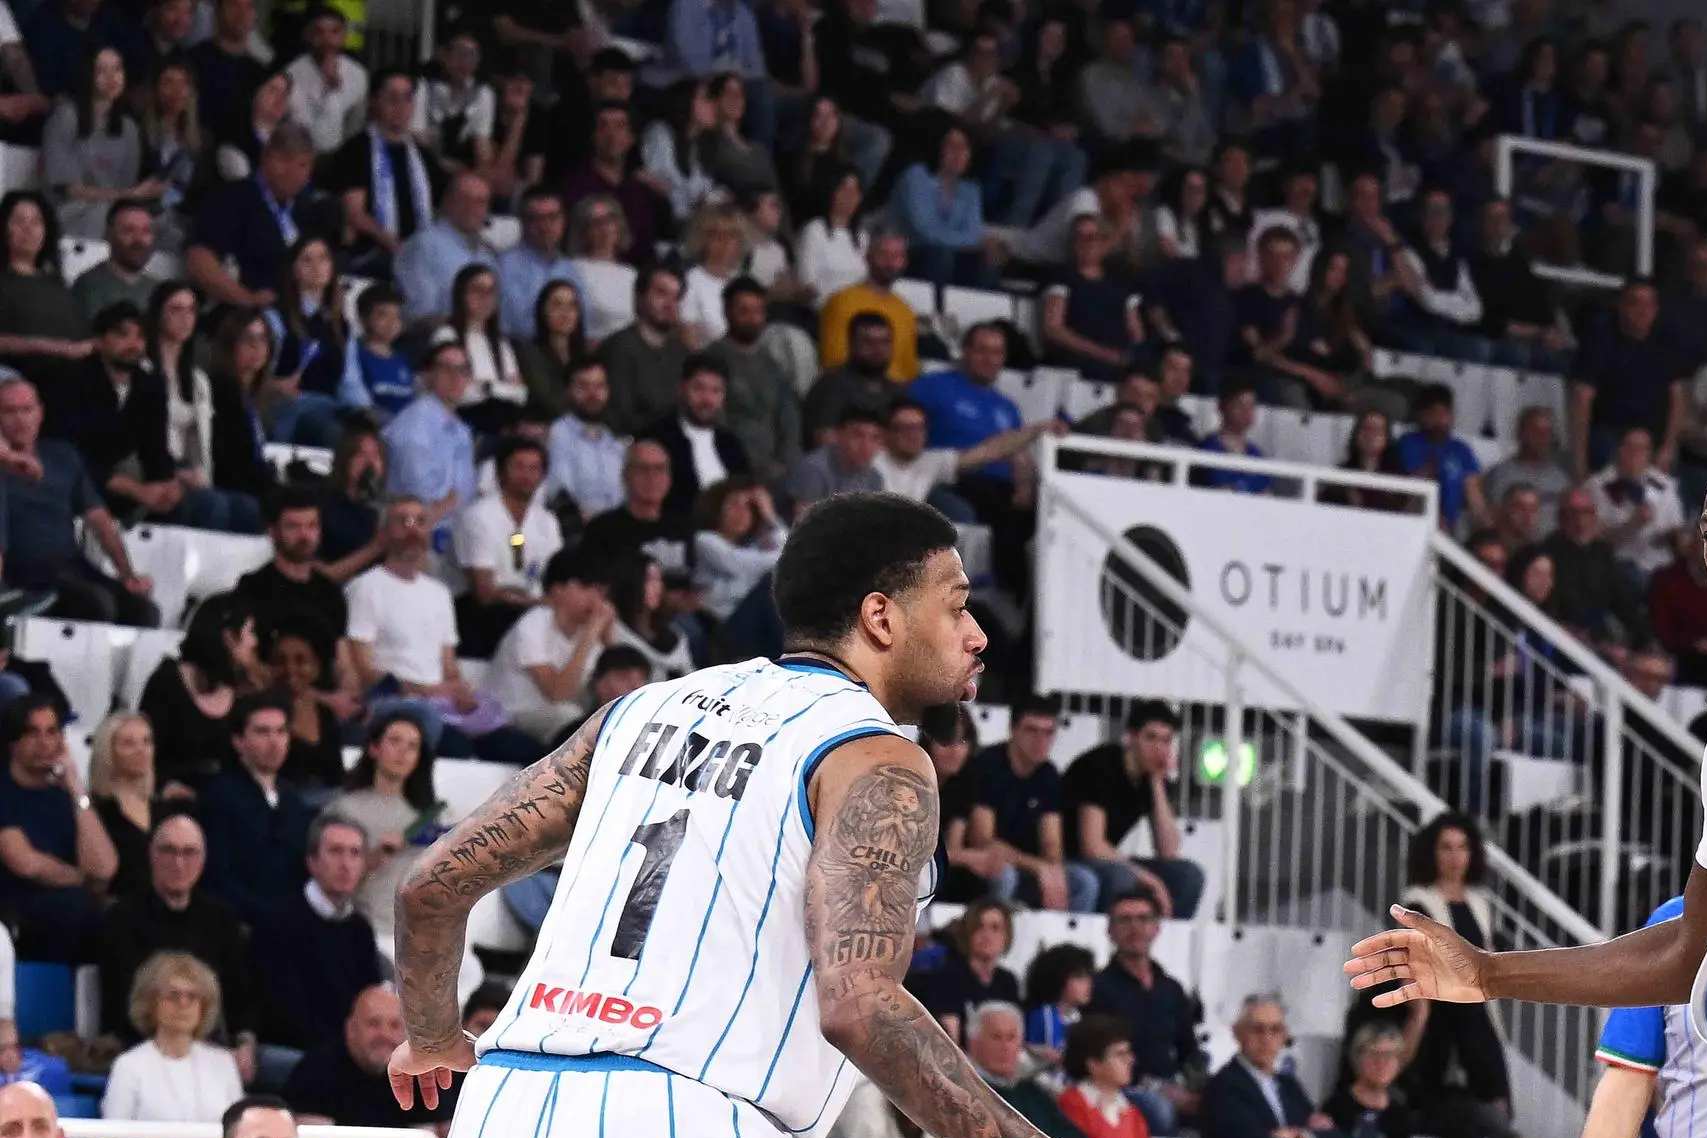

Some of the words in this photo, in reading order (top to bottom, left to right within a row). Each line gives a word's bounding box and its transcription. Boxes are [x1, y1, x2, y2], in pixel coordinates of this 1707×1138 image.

[1219, 559, 1389, 622] OTIUM
[681, 688, 732, 717] fruit
[849, 844, 911, 873] CHILD
[609, 807, 691, 961] 1
[529, 982, 664, 1030] KIMBO
